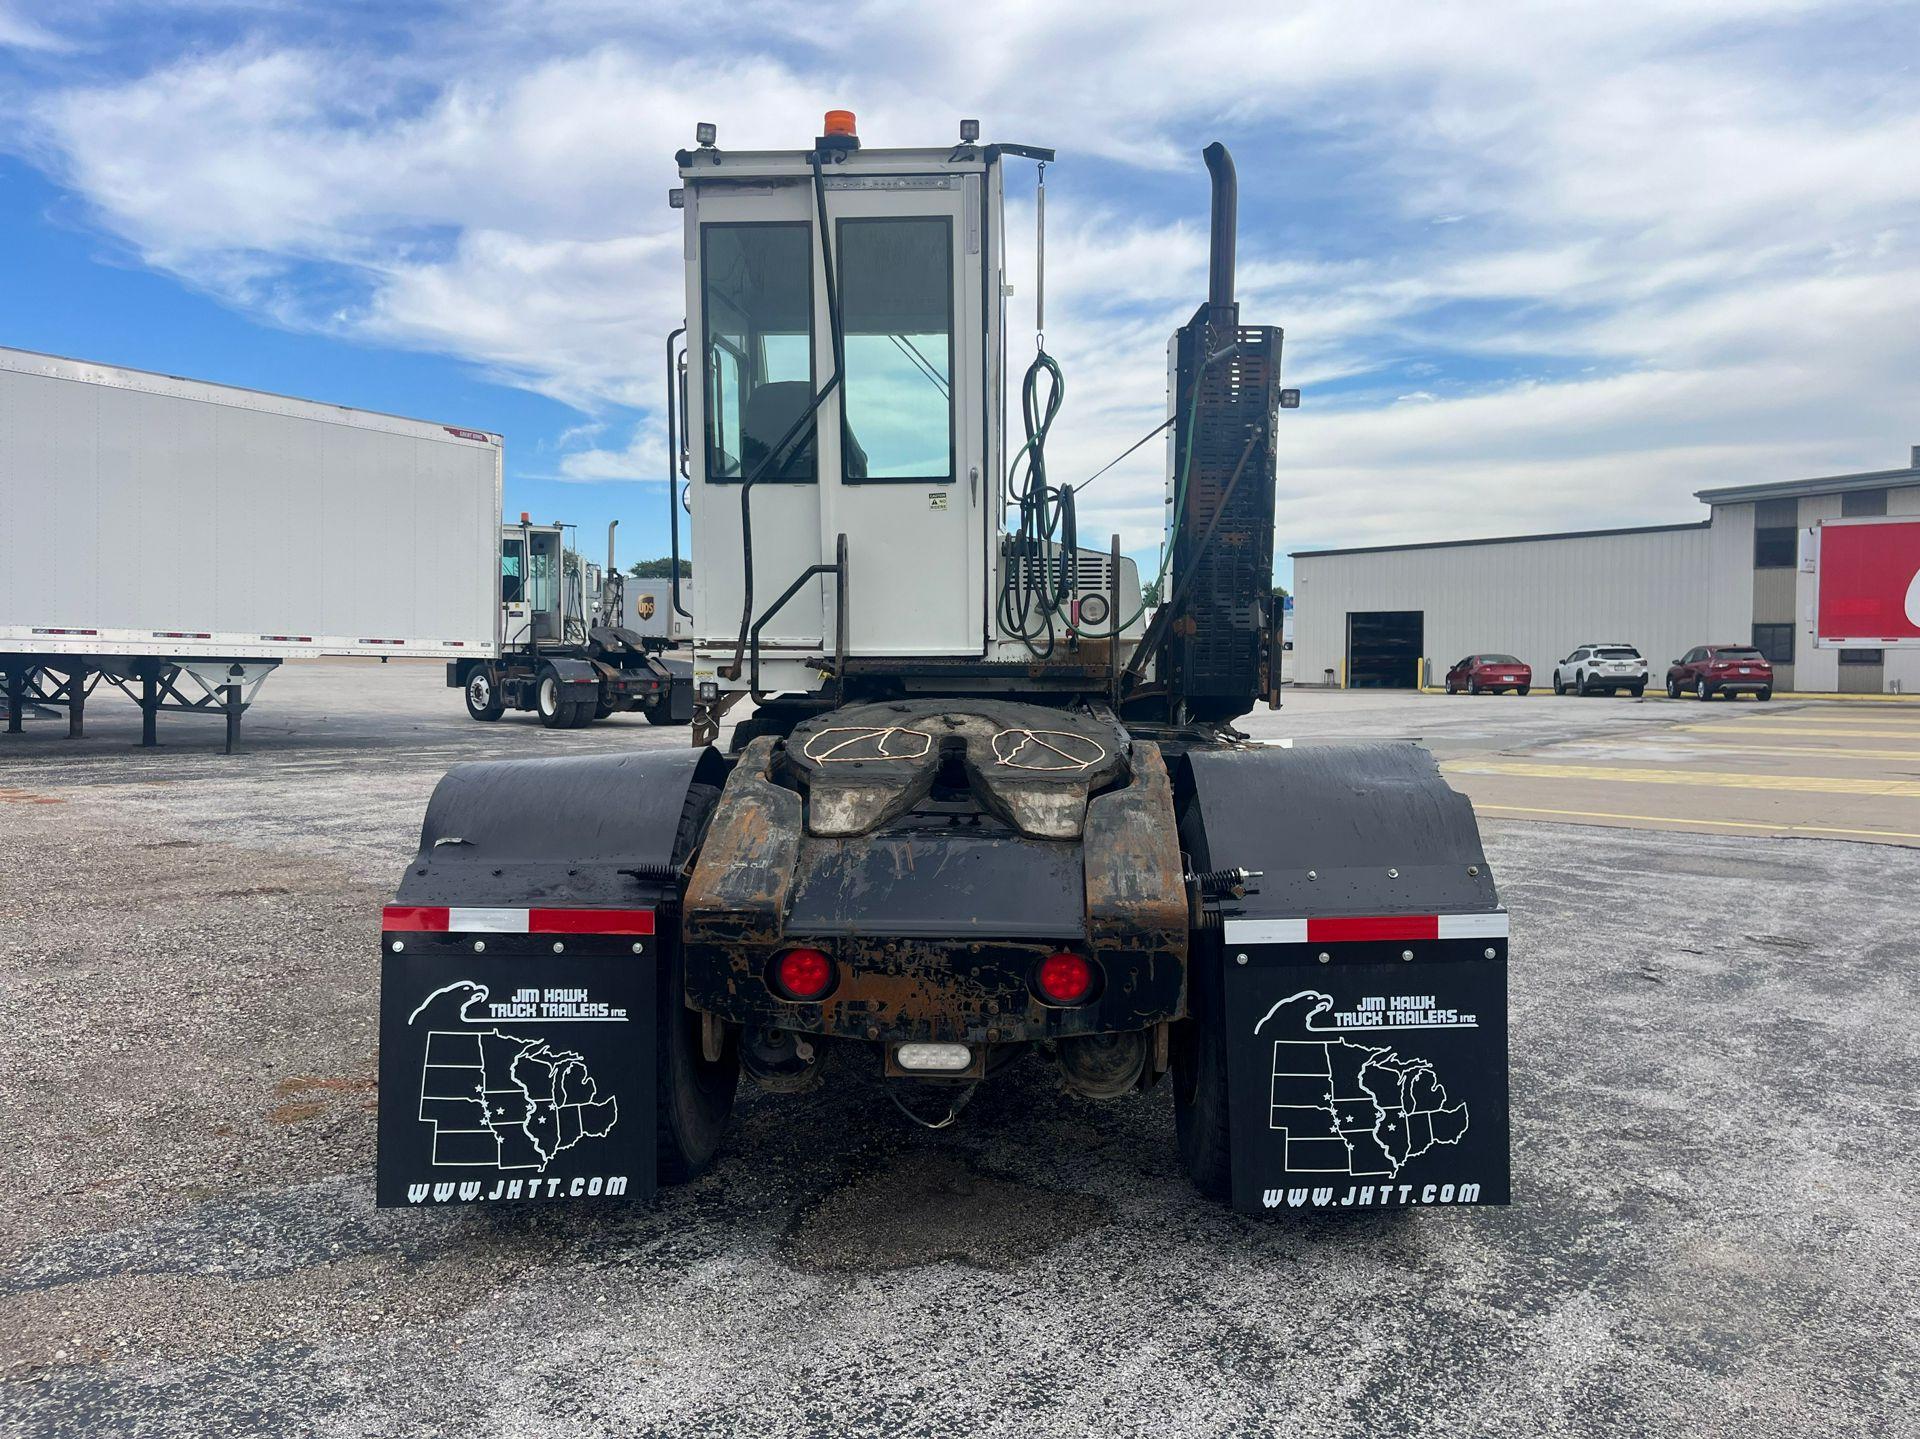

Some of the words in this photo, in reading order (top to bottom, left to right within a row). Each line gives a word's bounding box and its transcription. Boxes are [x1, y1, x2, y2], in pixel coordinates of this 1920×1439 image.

[511, 988, 540, 1003] JIM
[544, 988, 588, 1003] HAWK
[1357, 996, 1386, 1011] JIM
[1390, 995, 1436, 1011] HAWK
[489, 1003, 538, 1018] TRUCK
[540, 1002, 609, 1018] TRAILERS
[1334, 1011, 1383, 1027] TRUCK
[1386, 1009, 1458, 1025] TRAILERS
[407, 1176, 628, 1204] WWW.JHTT.COM
[1262, 1183, 1481, 1208] WWW.JHTT.COM
